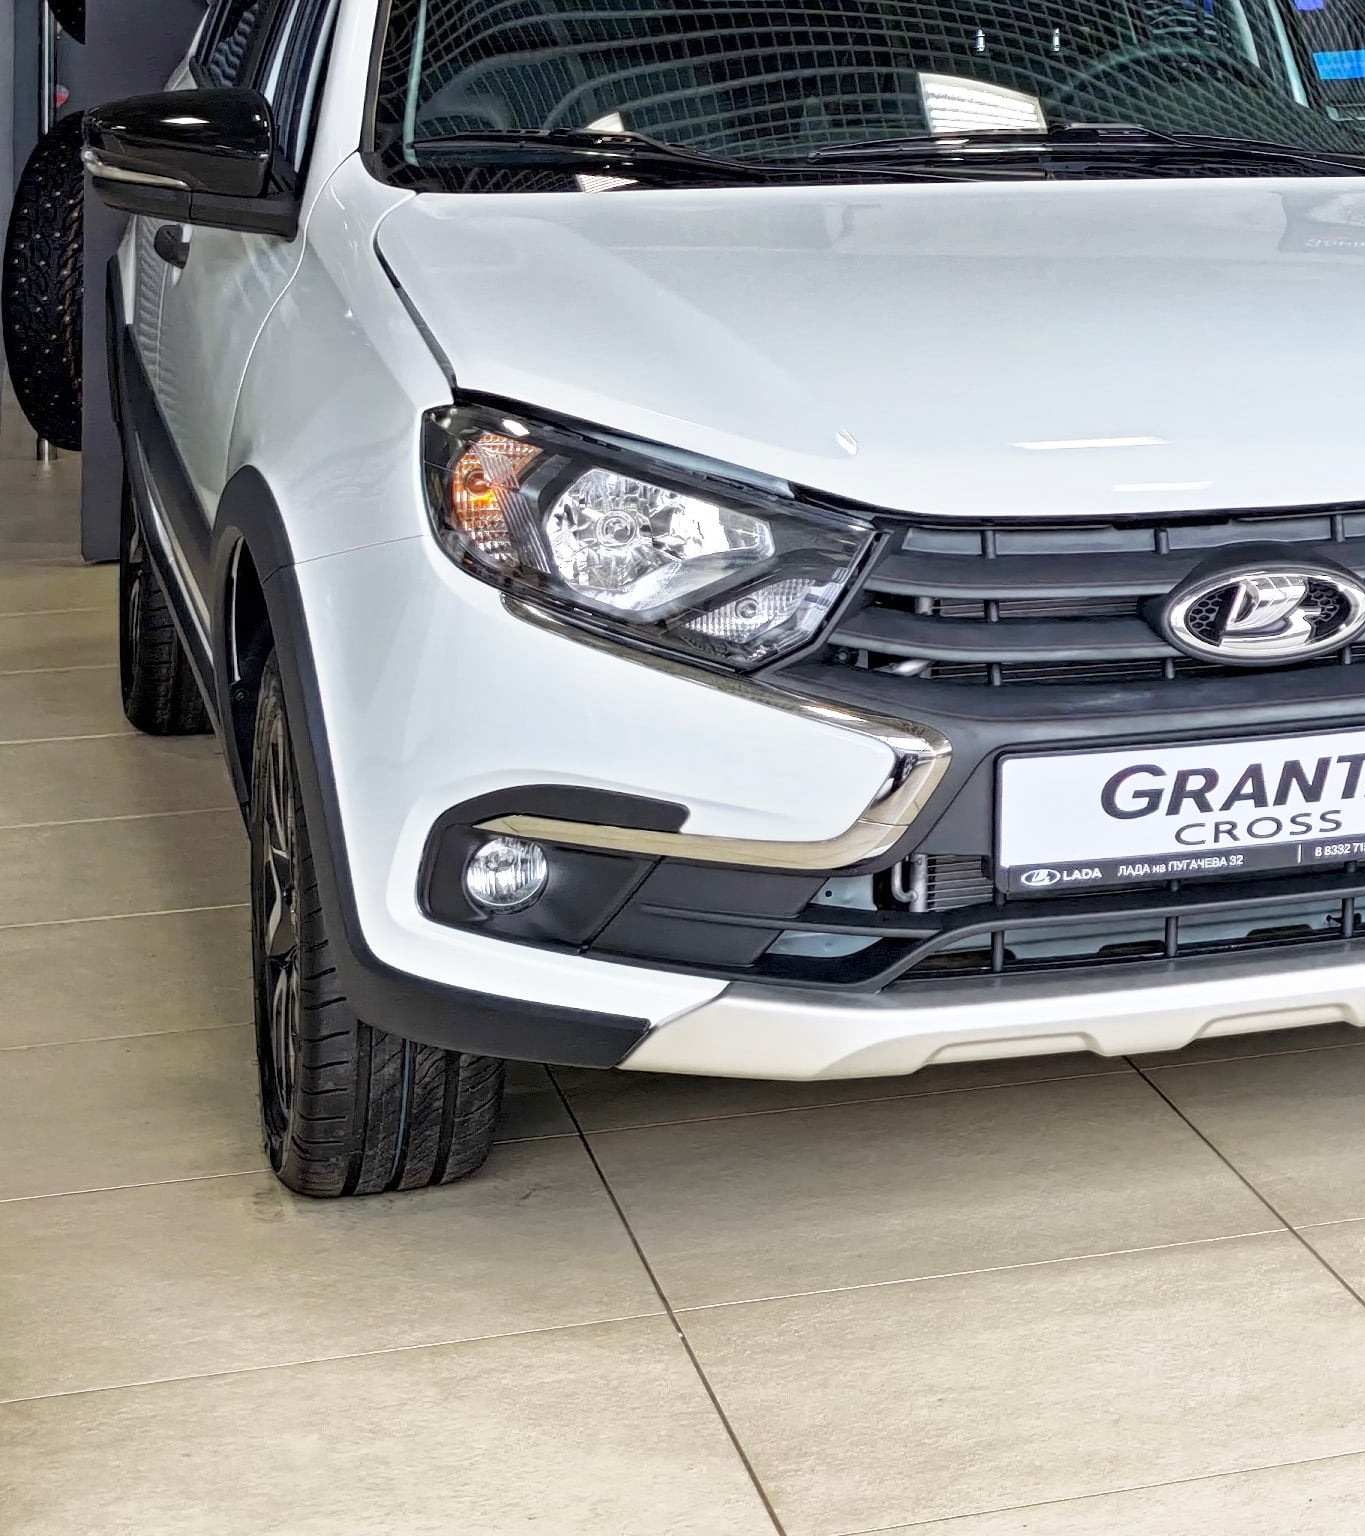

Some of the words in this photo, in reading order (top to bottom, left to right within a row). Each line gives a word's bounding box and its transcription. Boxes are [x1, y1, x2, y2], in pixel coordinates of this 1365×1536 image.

[1174, 809, 1343, 846] CROSS
[1314, 846, 1322, 857] 8
[1324, 843, 1351, 856] 8332
[1063, 868, 1102, 881] LADA
[1117, 865, 1151, 877] ЛАДА
[1168, 856, 1228, 872] ПУГАЧЕВА
[1229, 854, 1244, 866] 32
